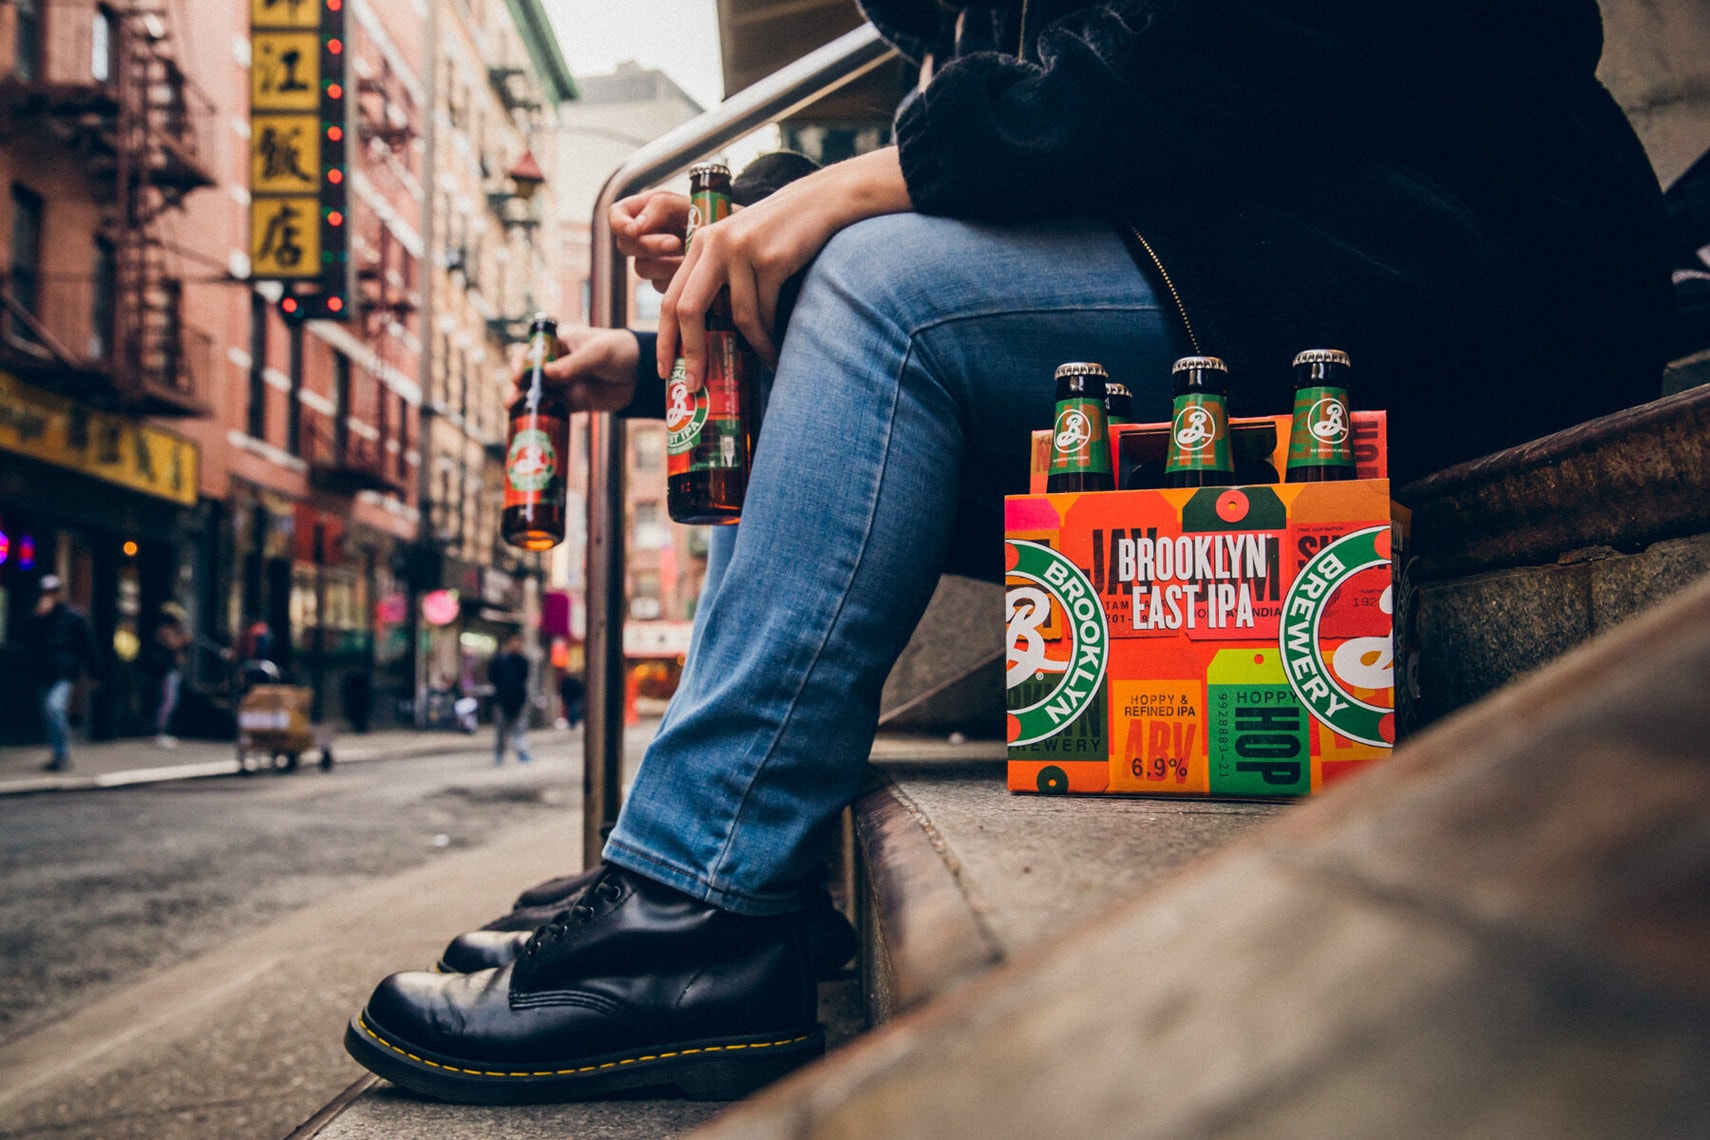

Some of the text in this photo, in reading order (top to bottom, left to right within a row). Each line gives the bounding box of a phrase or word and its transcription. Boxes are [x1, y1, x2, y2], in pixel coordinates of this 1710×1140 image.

[1118, 533, 1267, 582] BROOKLYN
[1132, 583, 1255, 630] EAST IPA
[1043, 560, 1101, 724] BROOKLYN
[1287, 553, 1350, 718] BREWERY
[1124, 706, 1196, 717] REFINED IPA
[1131, 694, 1188, 706] HOPPY &
[1236, 691, 1298, 704] HOPPY
[1122, 719, 1197, 785] ABV
[1131, 757, 1188, 777] 6.9%
[1235, 707, 1301, 785] HOP
